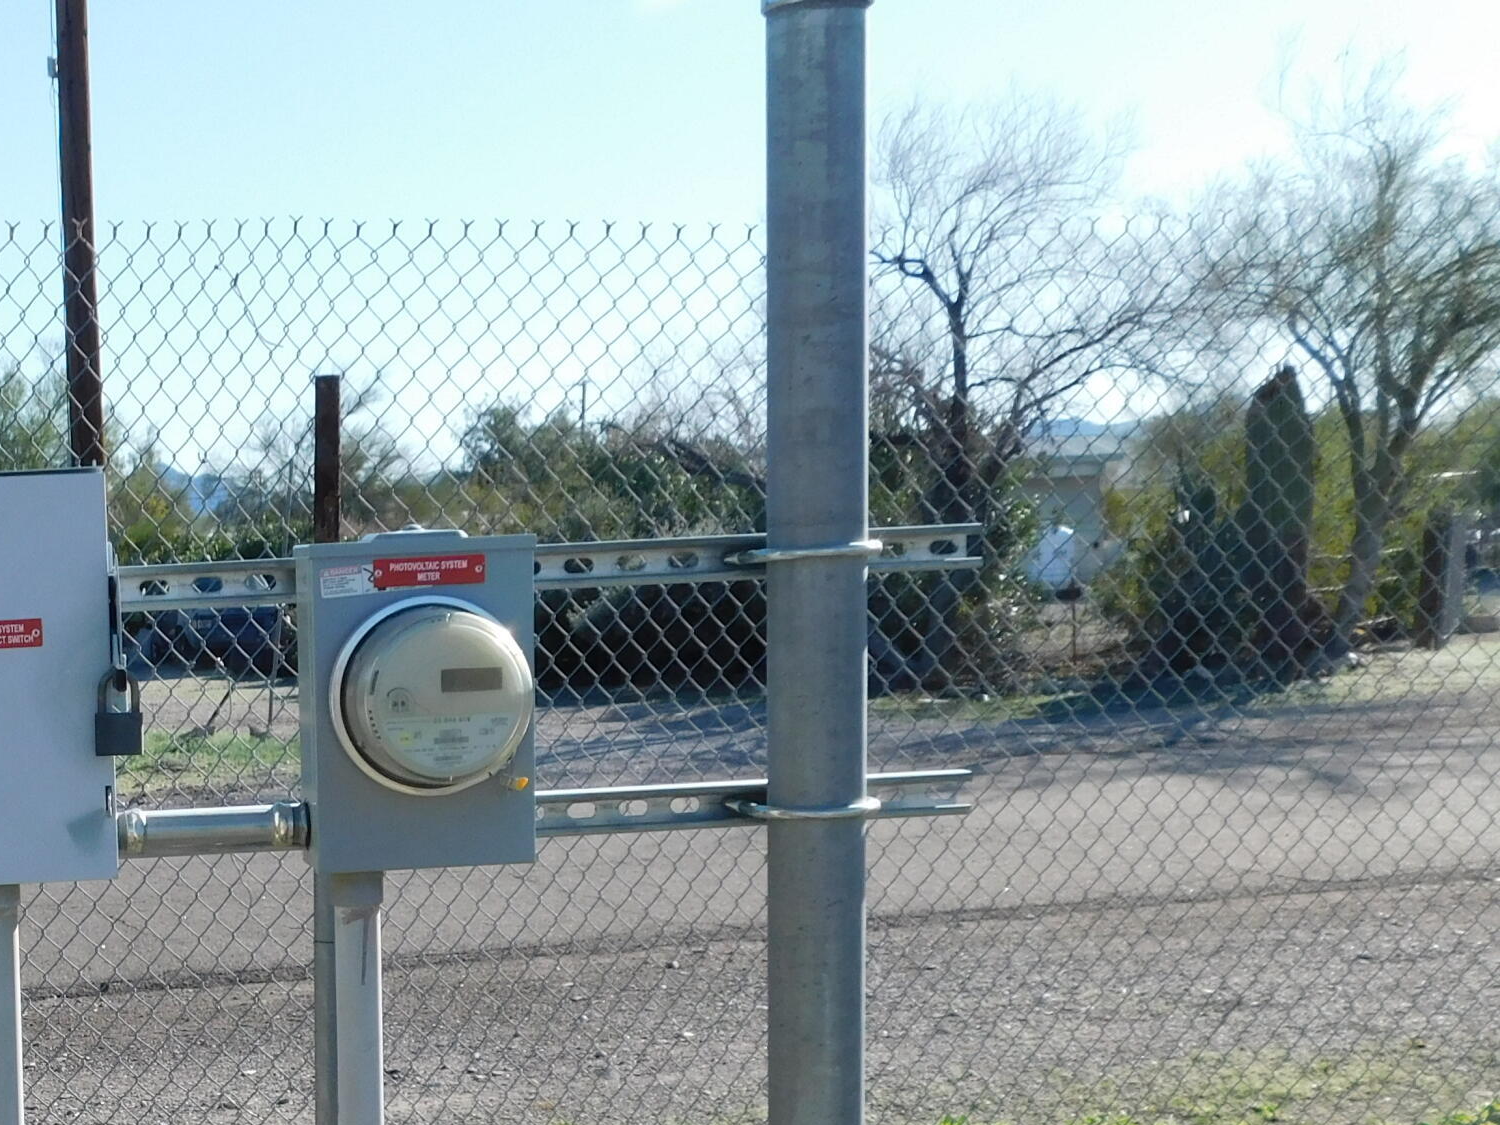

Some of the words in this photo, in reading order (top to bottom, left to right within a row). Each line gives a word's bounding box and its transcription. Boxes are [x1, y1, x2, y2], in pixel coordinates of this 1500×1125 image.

[389, 561, 439, 571] PHOTOVOLTAIC
[440, 559, 468, 570] SYSTEM
[417, 572, 441, 582] METER
[7, 634, 34, 644] SWITCH
